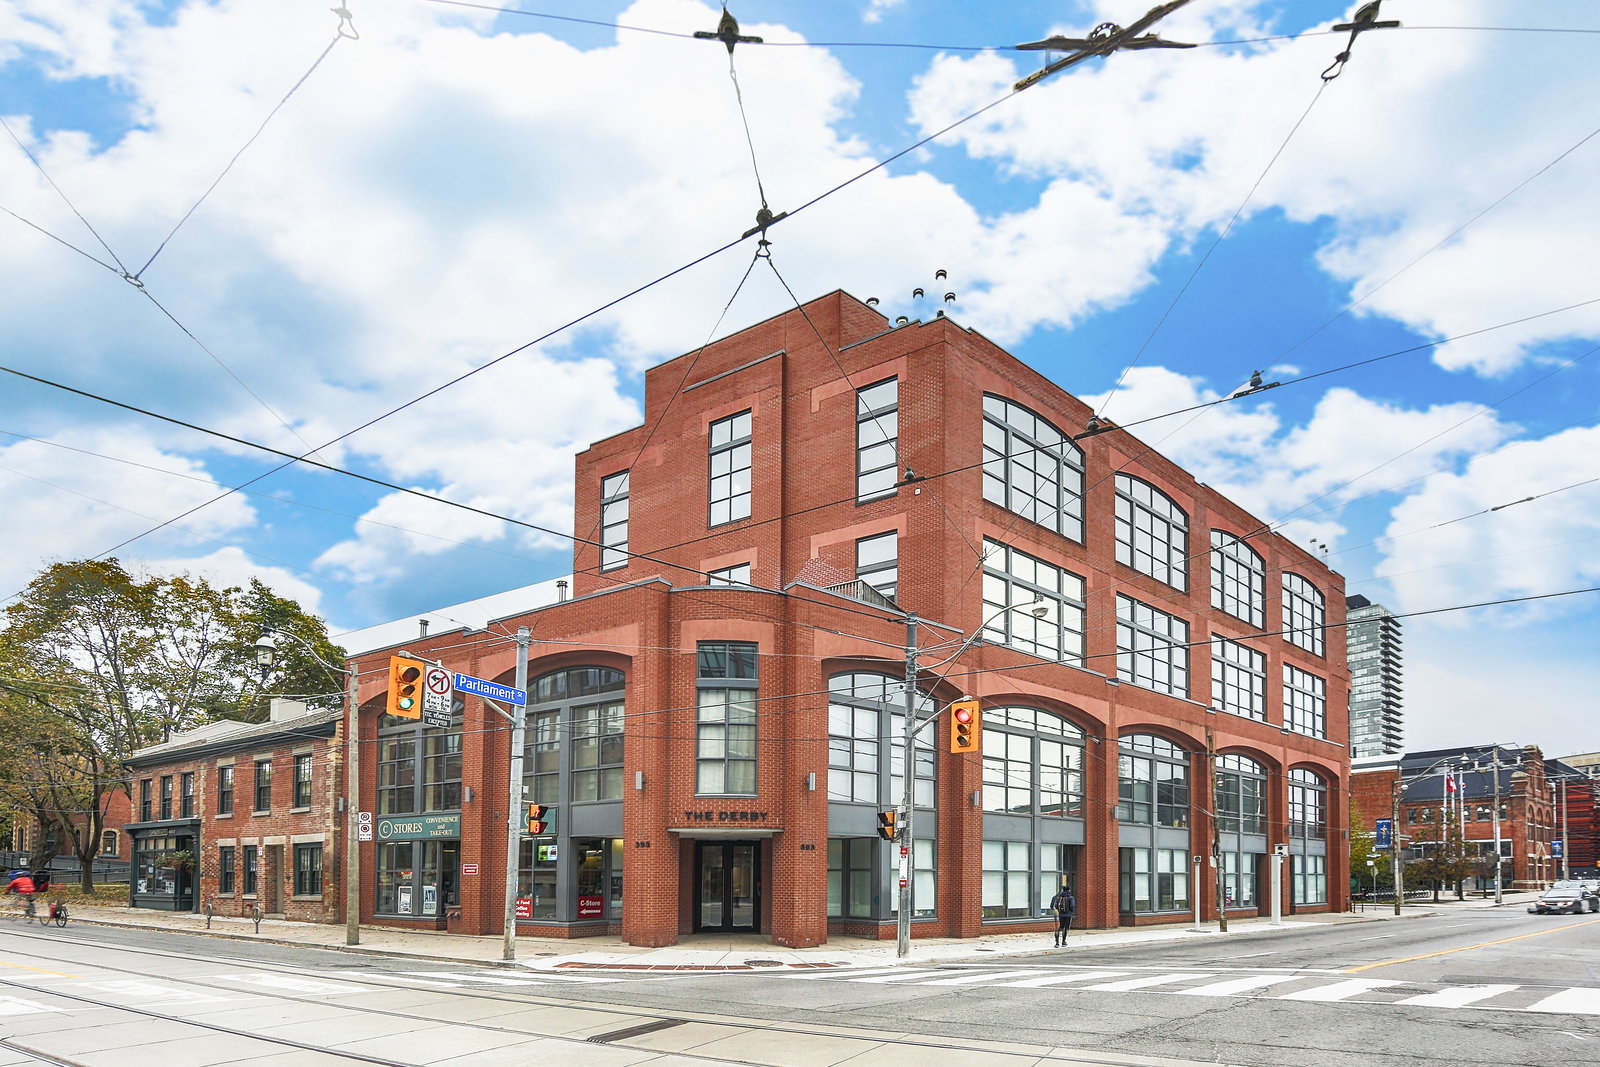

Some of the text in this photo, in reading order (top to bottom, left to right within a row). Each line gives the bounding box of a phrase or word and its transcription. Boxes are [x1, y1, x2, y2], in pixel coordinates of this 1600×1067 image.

[459, 675, 515, 700] Parliament
[425, 816, 459, 824] CONVENIENCE
[685, 811, 768, 821] THE DERBY
[393, 823, 423, 834] STORES
